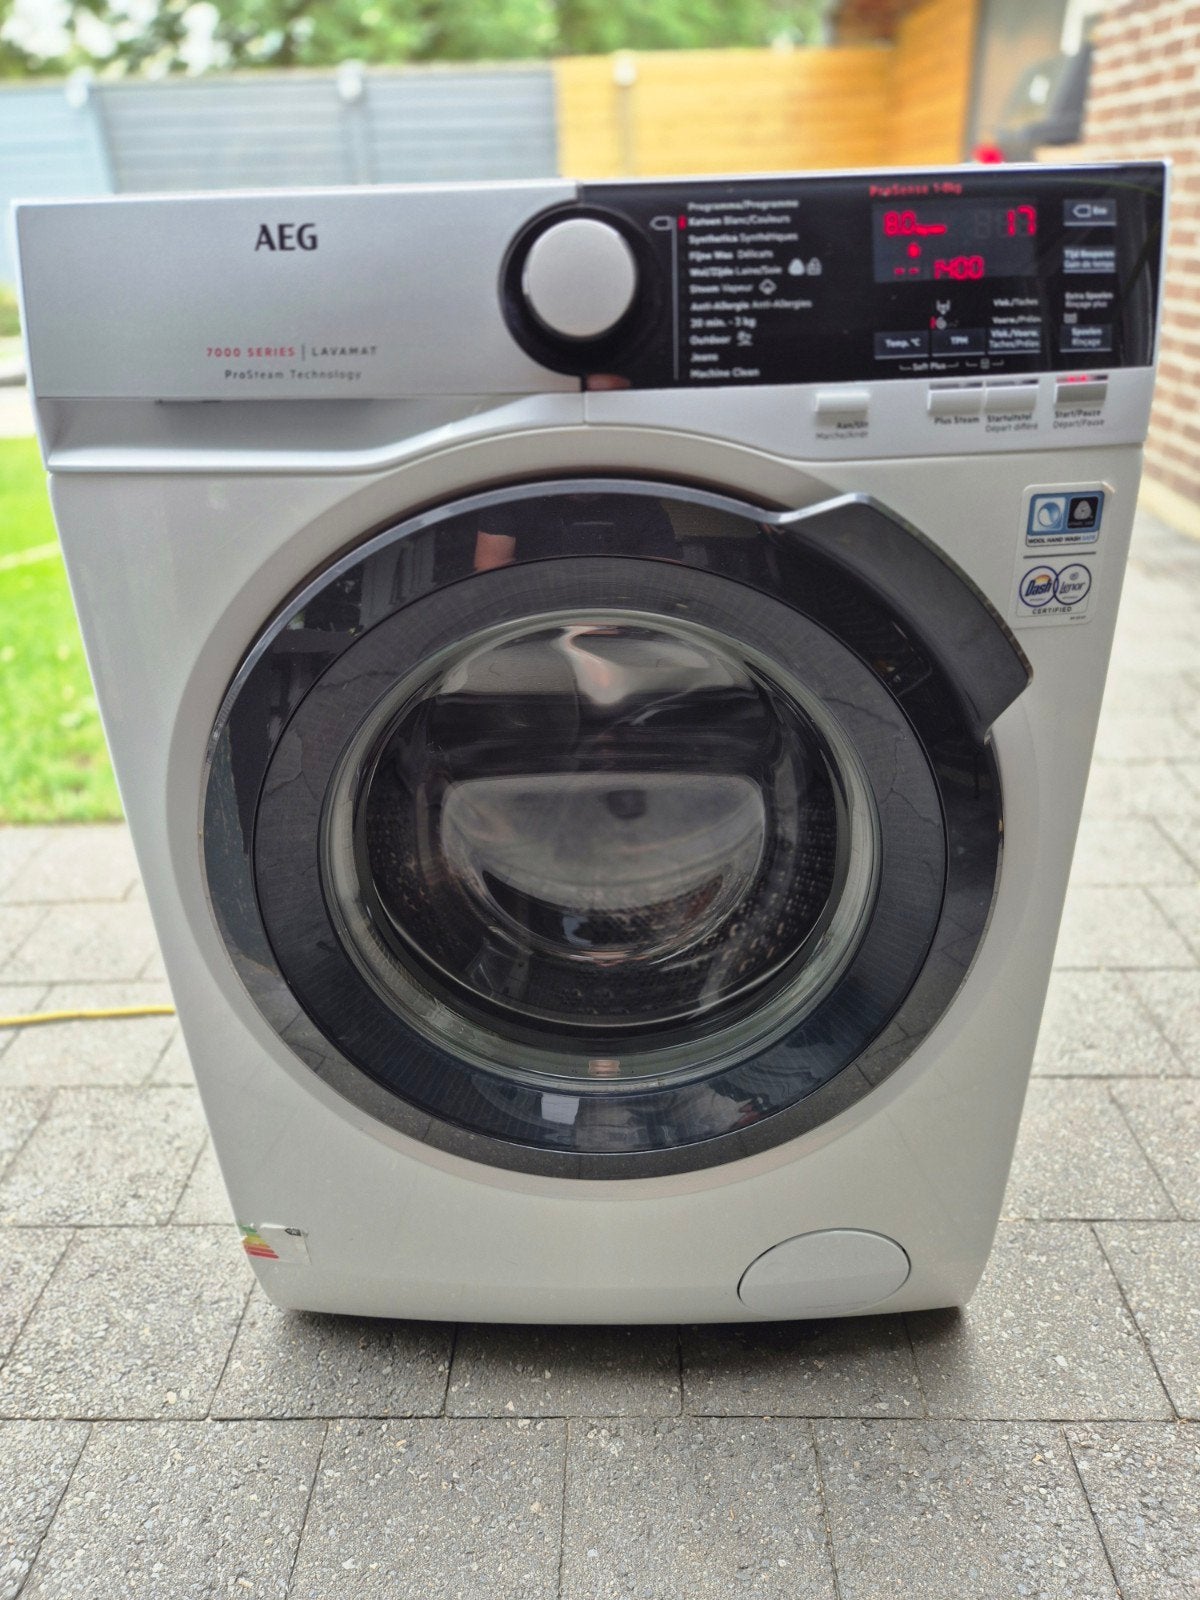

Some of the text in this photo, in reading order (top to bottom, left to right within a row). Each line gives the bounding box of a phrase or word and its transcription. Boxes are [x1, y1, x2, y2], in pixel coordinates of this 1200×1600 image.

[869, 184, 929, 197] ProSense
[1007, 205, 1037, 236] 17
[255, 223, 318, 251] AEG
[934, 256, 984, 280] 1400
[206, 346, 377, 357] 7000 SERIES LAVAMAT
[225, 370, 361, 380] ProSteam Technology
[987, 414, 1031, 422] Startuitstel
[1055, 410, 1100, 418] Start/Pauze
[1025, 579, 1085, 596] Dash Lenor
